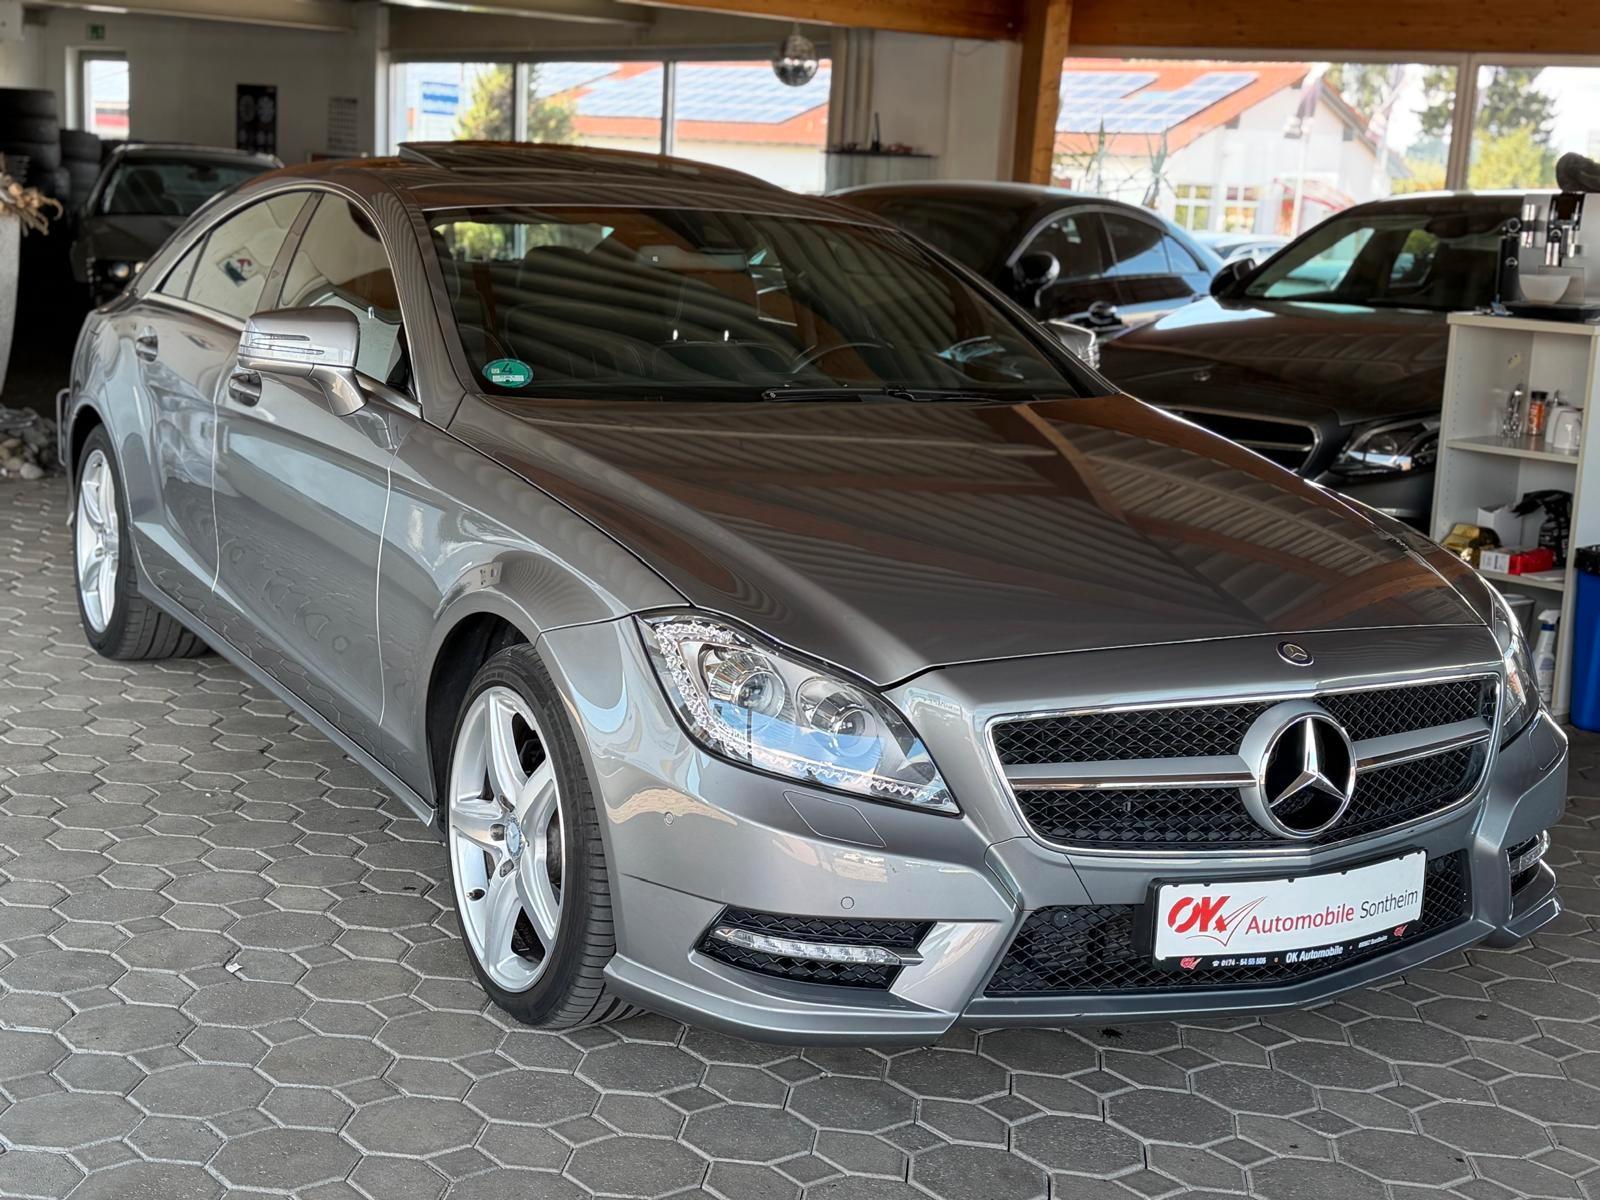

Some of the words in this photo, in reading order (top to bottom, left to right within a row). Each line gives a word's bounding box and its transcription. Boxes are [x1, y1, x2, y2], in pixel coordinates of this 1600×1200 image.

[1245, 903, 1355, 935] Automobile
[1360, 889, 1419, 919] Sontheim
[1286, 952, 1298, 963] OK
[1299, 945, 1344, 961] Automobile
